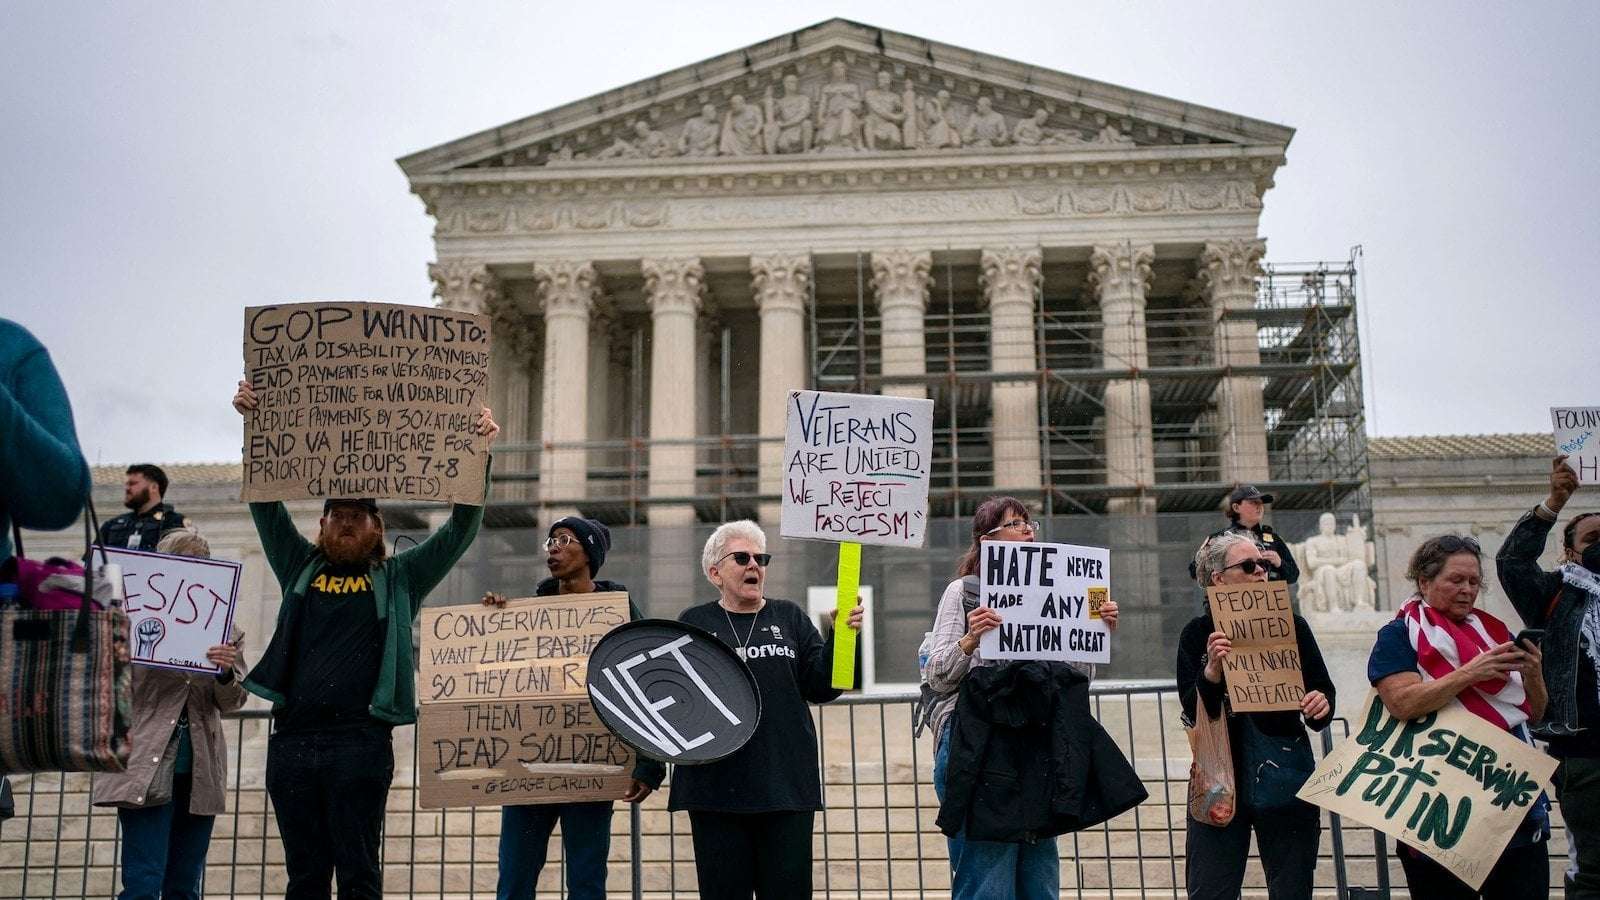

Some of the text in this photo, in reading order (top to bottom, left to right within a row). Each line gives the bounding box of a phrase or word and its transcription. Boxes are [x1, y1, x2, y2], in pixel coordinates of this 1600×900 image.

[251, 307, 486, 344] GOP WANTS TO:
[253, 342, 489, 368] TAX VA DISABILITY PAYMENTS
[252, 368, 293, 391] END
[298, 364, 369, 383] PAYMENTS
[372, 364, 389, 377] FOR
[392, 362, 419, 379] VETS
[421, 363, 451, 381] RATED
[256, 382, 476, 408] MEANS TESTING FOR VA DISABILITY
[252, 407, 305, 432] REDUCE
[309, 405, 372, 429] PAYMENTS
[377, 408, 392, 429] BY
[396, 408, 432, 431] 30%
[434, 412, 448, 431] AT
[448, 412, 467, 433] AGE
[1555, 409, 1600, 429] FOUN
[251, 430, 475, 459] END VA HEALTHCARE FOR
[250, 455, 326, 484] PRIORITY
[333, 454, 406, 476] GROUPS
[789, 446, 925, 477] ARE UNITED.
[329, 478, 388, 496] MILLION
[393, 476, 441, 497] VETS)
[789, 478, 906, 511] WE REJECT
[987, 546, 1103, 587] HATE NEVER
[123, 573, 228, 630] ESIST
[987, 592, 1023, 609] MADE
[1040, 592, 1085, 619] ANY
[1215, 589, 1288, 612] PEOPLE
[434, 606, 625, 641] CONSERVATIVES
[999, 622, 1105, 652] NATION GREAT
[1219, 617, 1290, 641] UNITED
[431, 633, 603, 665] WANT LIVE BABIE
[740, 644, 796, 659] OfVets
[1223, 649, 1302, 672] WILL NEVER
[432, 674, 456, 700] SO
[464, 669, 510, 698] THEY
[515, 667, 551, 697] CAN
[1247, 672, 1263, 684] BE
[588, 634, 742, 757] VET
[1233, 683, 1306, 705] DEFEATED
[463, 703, 591, 732] THEM TO BE
[432, 733, 630, 773] DEAD SOLDIERS
[485, 777, 545, 794] GEORGE
[549, 776, 603, 791] CARLIN
